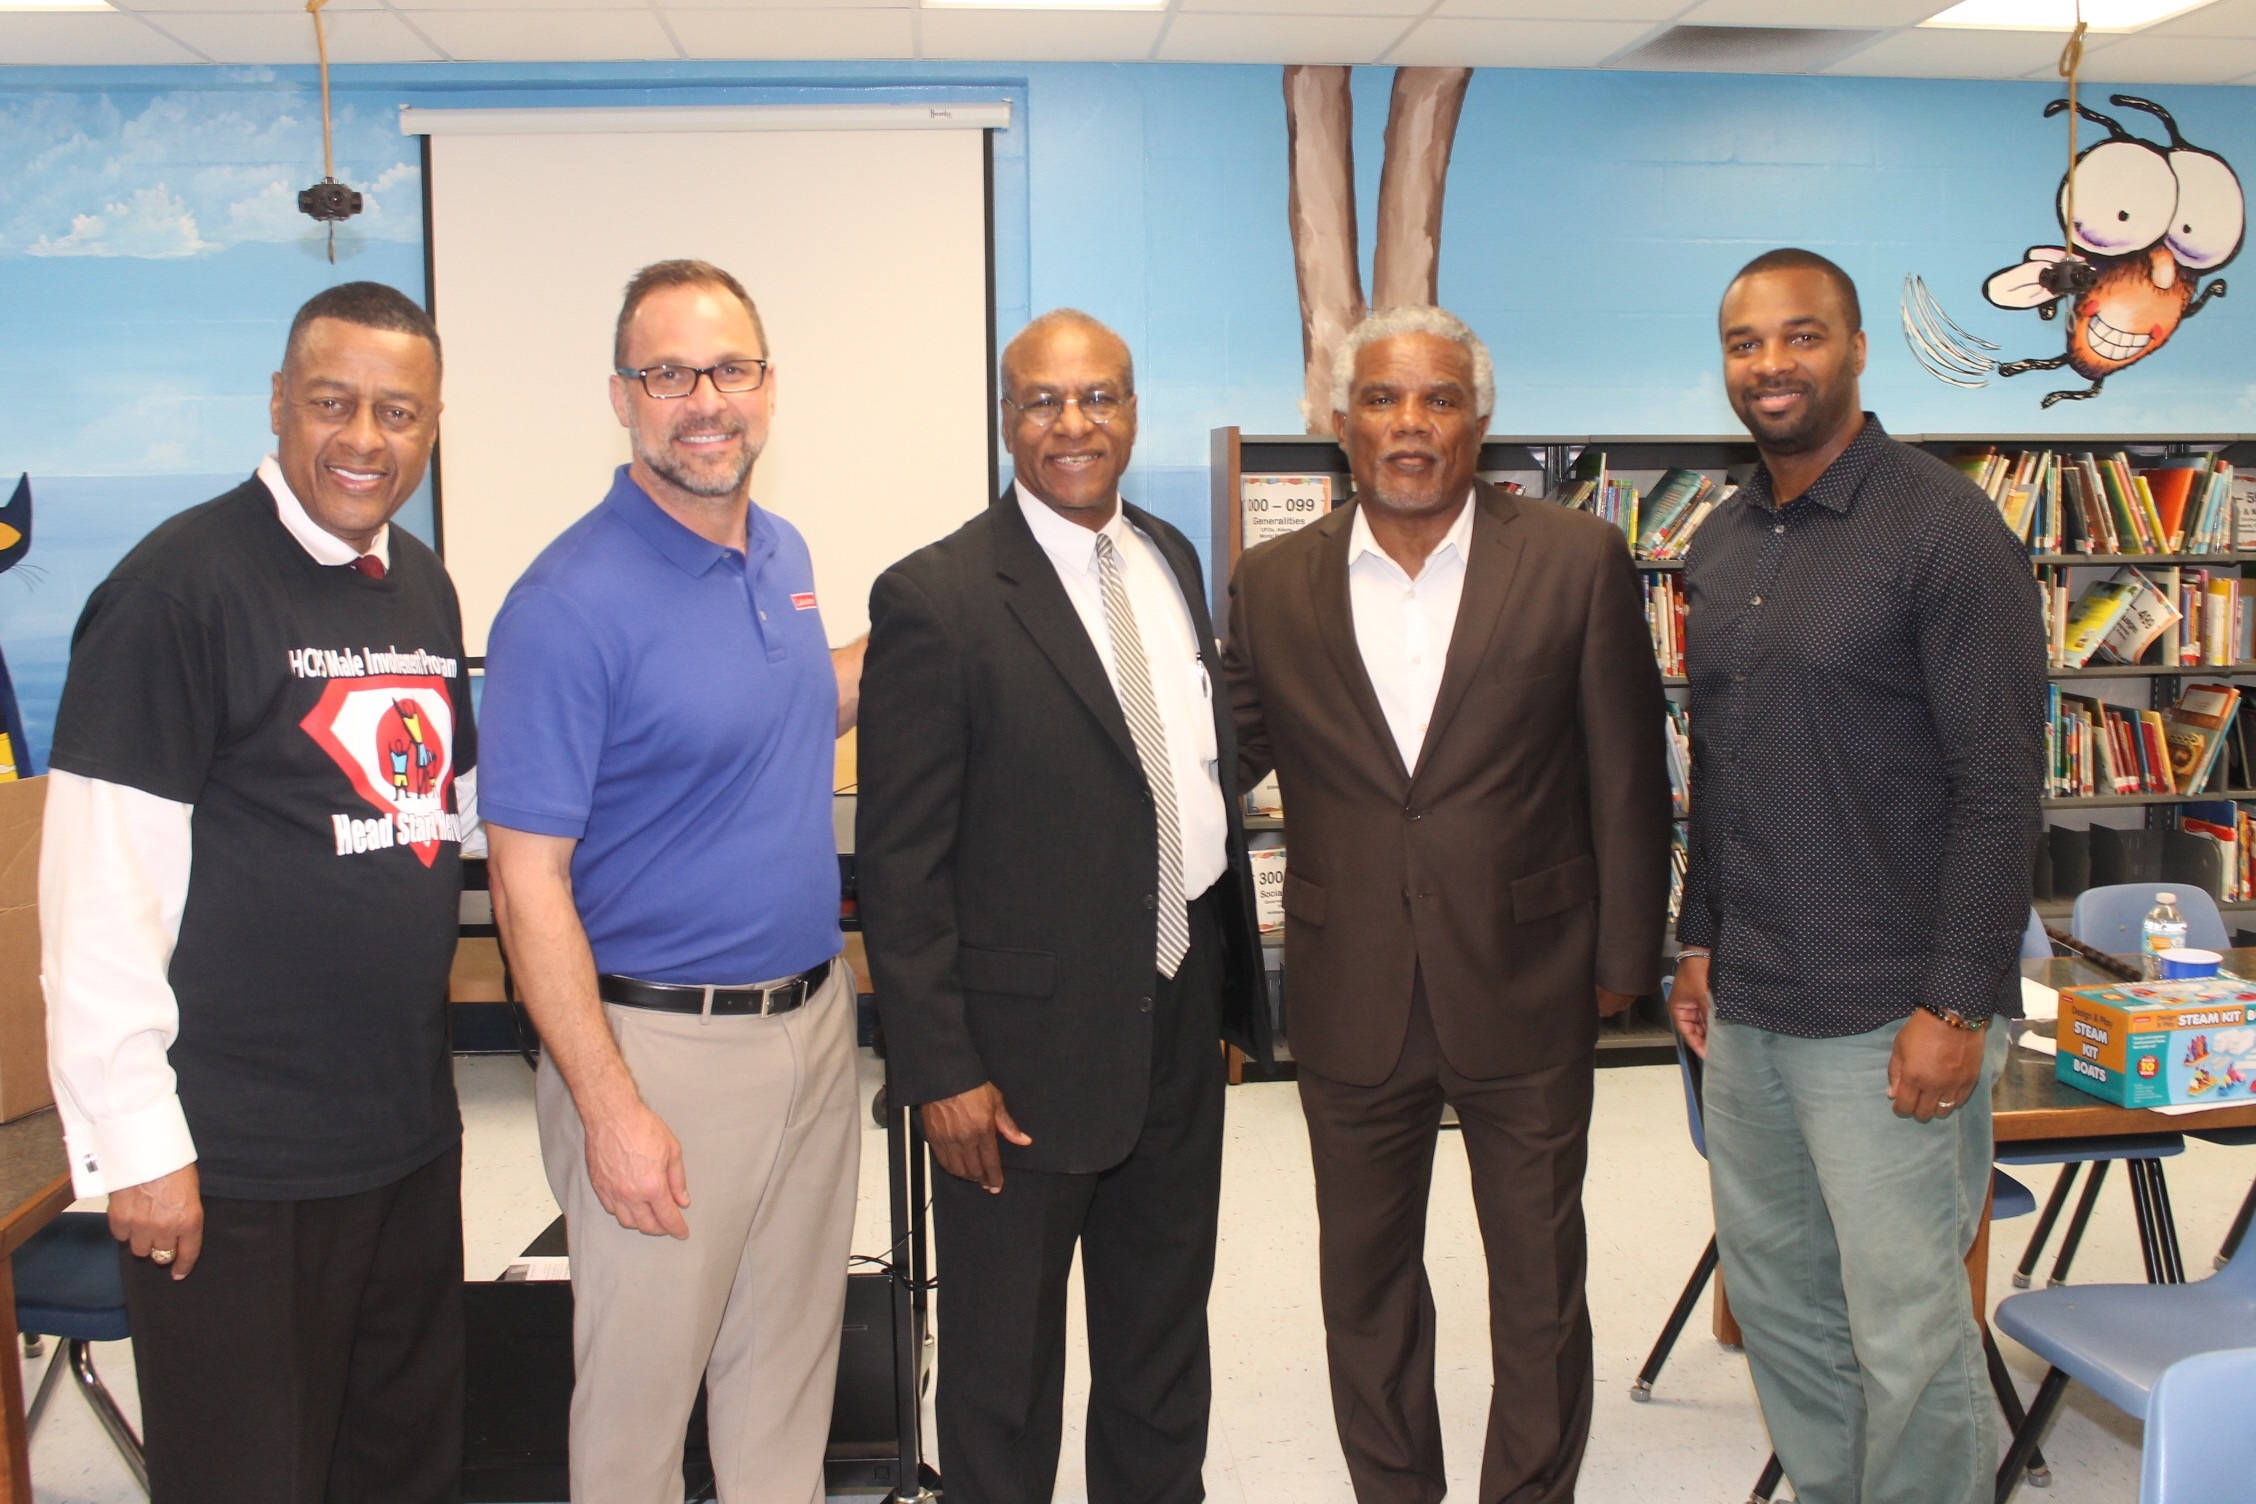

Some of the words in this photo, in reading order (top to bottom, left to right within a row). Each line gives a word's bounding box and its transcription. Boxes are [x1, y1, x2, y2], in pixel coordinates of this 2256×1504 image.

[1286, 498, 1315, 512] 099
[1253, 516, 1305, 526] Generalities
[324, 647, 365, 677] Male
[331, 812, 394, 856] Head
[397, 811, 436, 846] Start
[1259, 870, 1283, 885] 300
[1260, 889, 1283, 898] Socia
[2178, 1012, 2219, 1026] STEAM
[2222, 1010, 2242, 1024] KIT
[2074, 1020, 2108, 1045] STEAM
[2082, 1042, 2099, 1060] KIT
[2073, 1058, 2107, 1082] BOATS
[2141, 1062, 2155, 1072] 10
